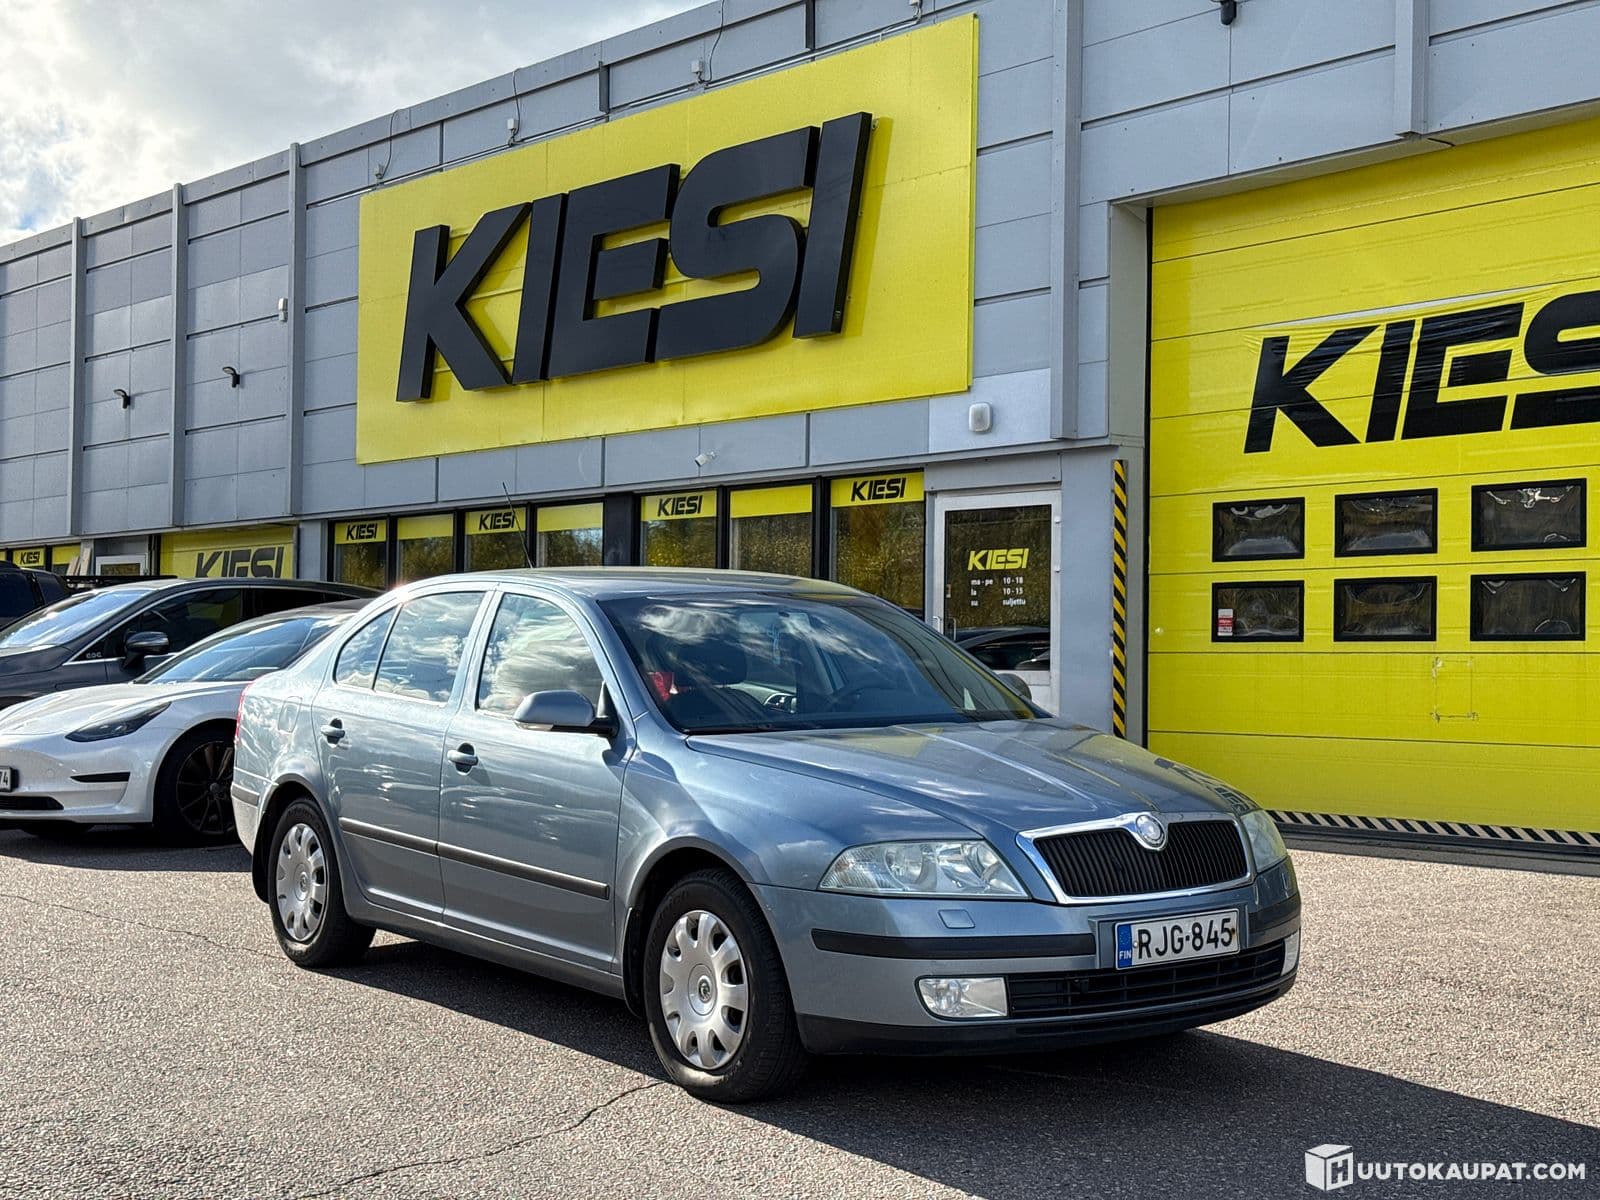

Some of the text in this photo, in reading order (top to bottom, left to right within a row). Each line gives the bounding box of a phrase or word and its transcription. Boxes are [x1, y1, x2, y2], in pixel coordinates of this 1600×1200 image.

[396, 112, 872, 402] KIESI
[851, 477, 906, 502] KIESI
[657, 495, 703, 517] KIESI
[346, 523, 378, 541] KIESI
[479, 511, 515, 531] KIESI
[20, 550, 41, 566] KIESI
[967, 548, 1030, 571] KIESI
[1137, 917, 1233, 960] RJG-845
[1119, 949, 1132, 961] FIN
